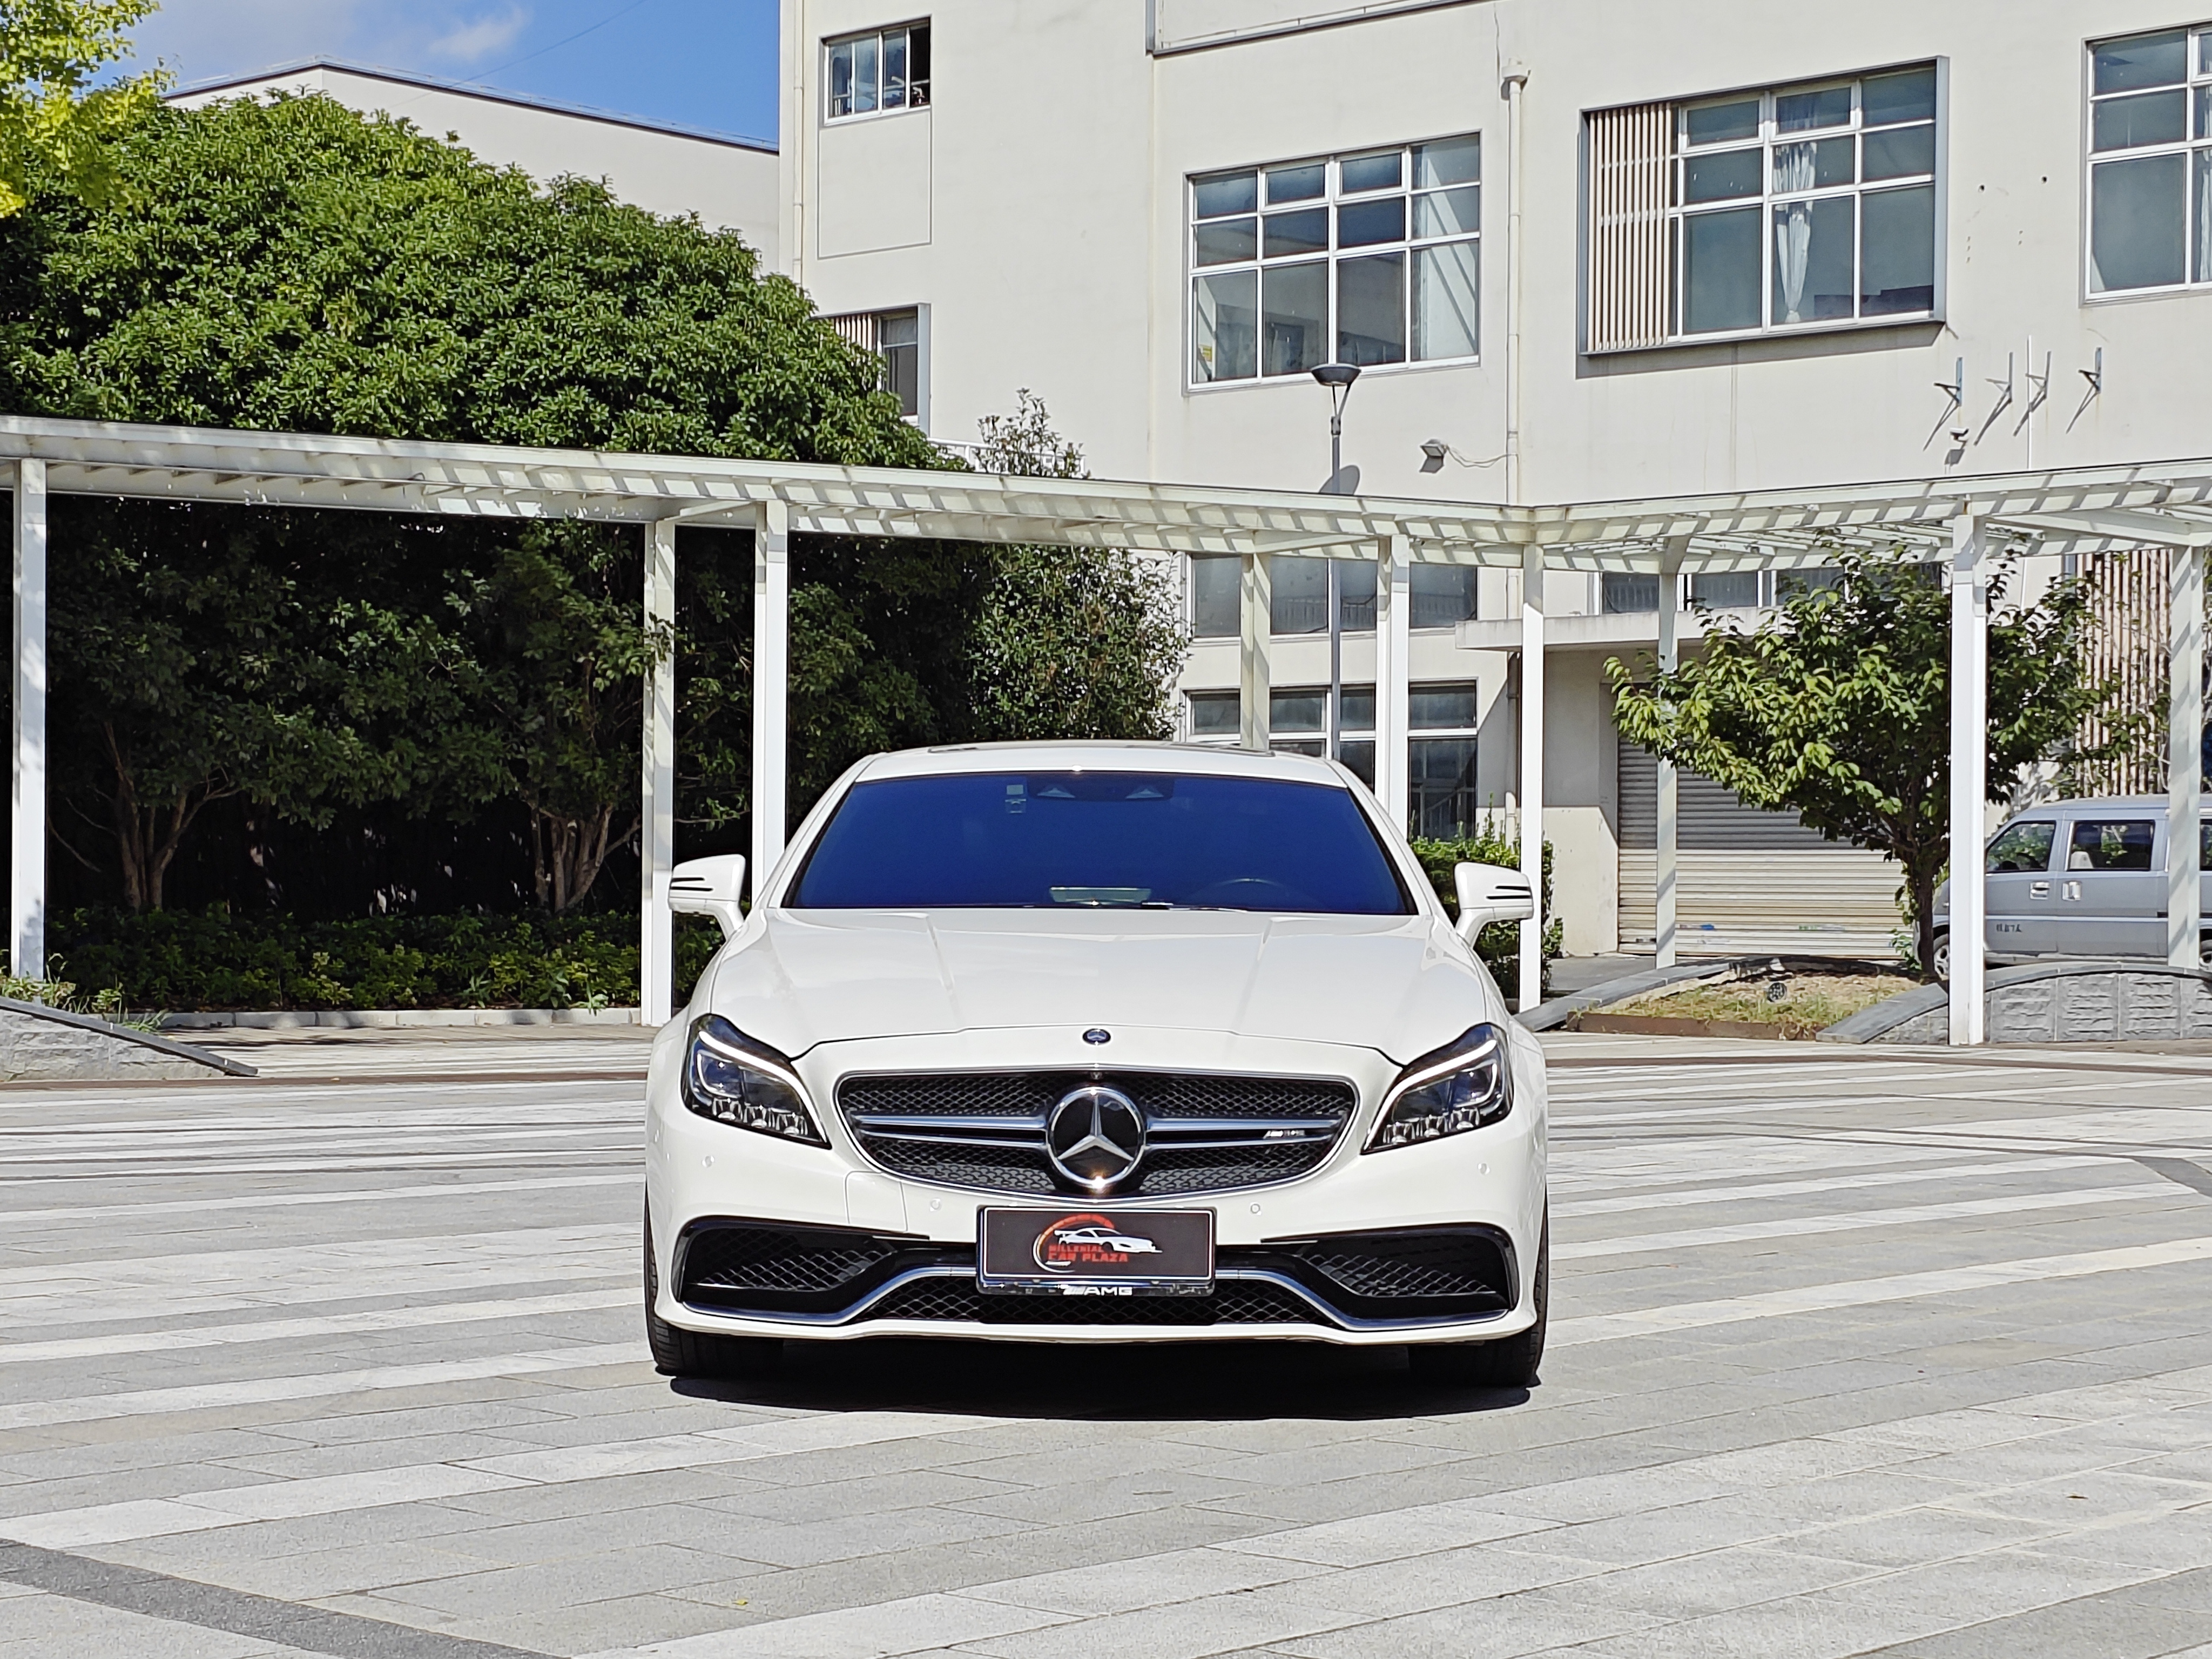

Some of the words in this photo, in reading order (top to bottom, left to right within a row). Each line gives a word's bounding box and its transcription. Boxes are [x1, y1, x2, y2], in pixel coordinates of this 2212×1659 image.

[1048, 1252, 1076, 1261] CAR
[1082, 1252, 1128, 1262] PLAZA
[1083, 1286, 1132, 1296] AMG
